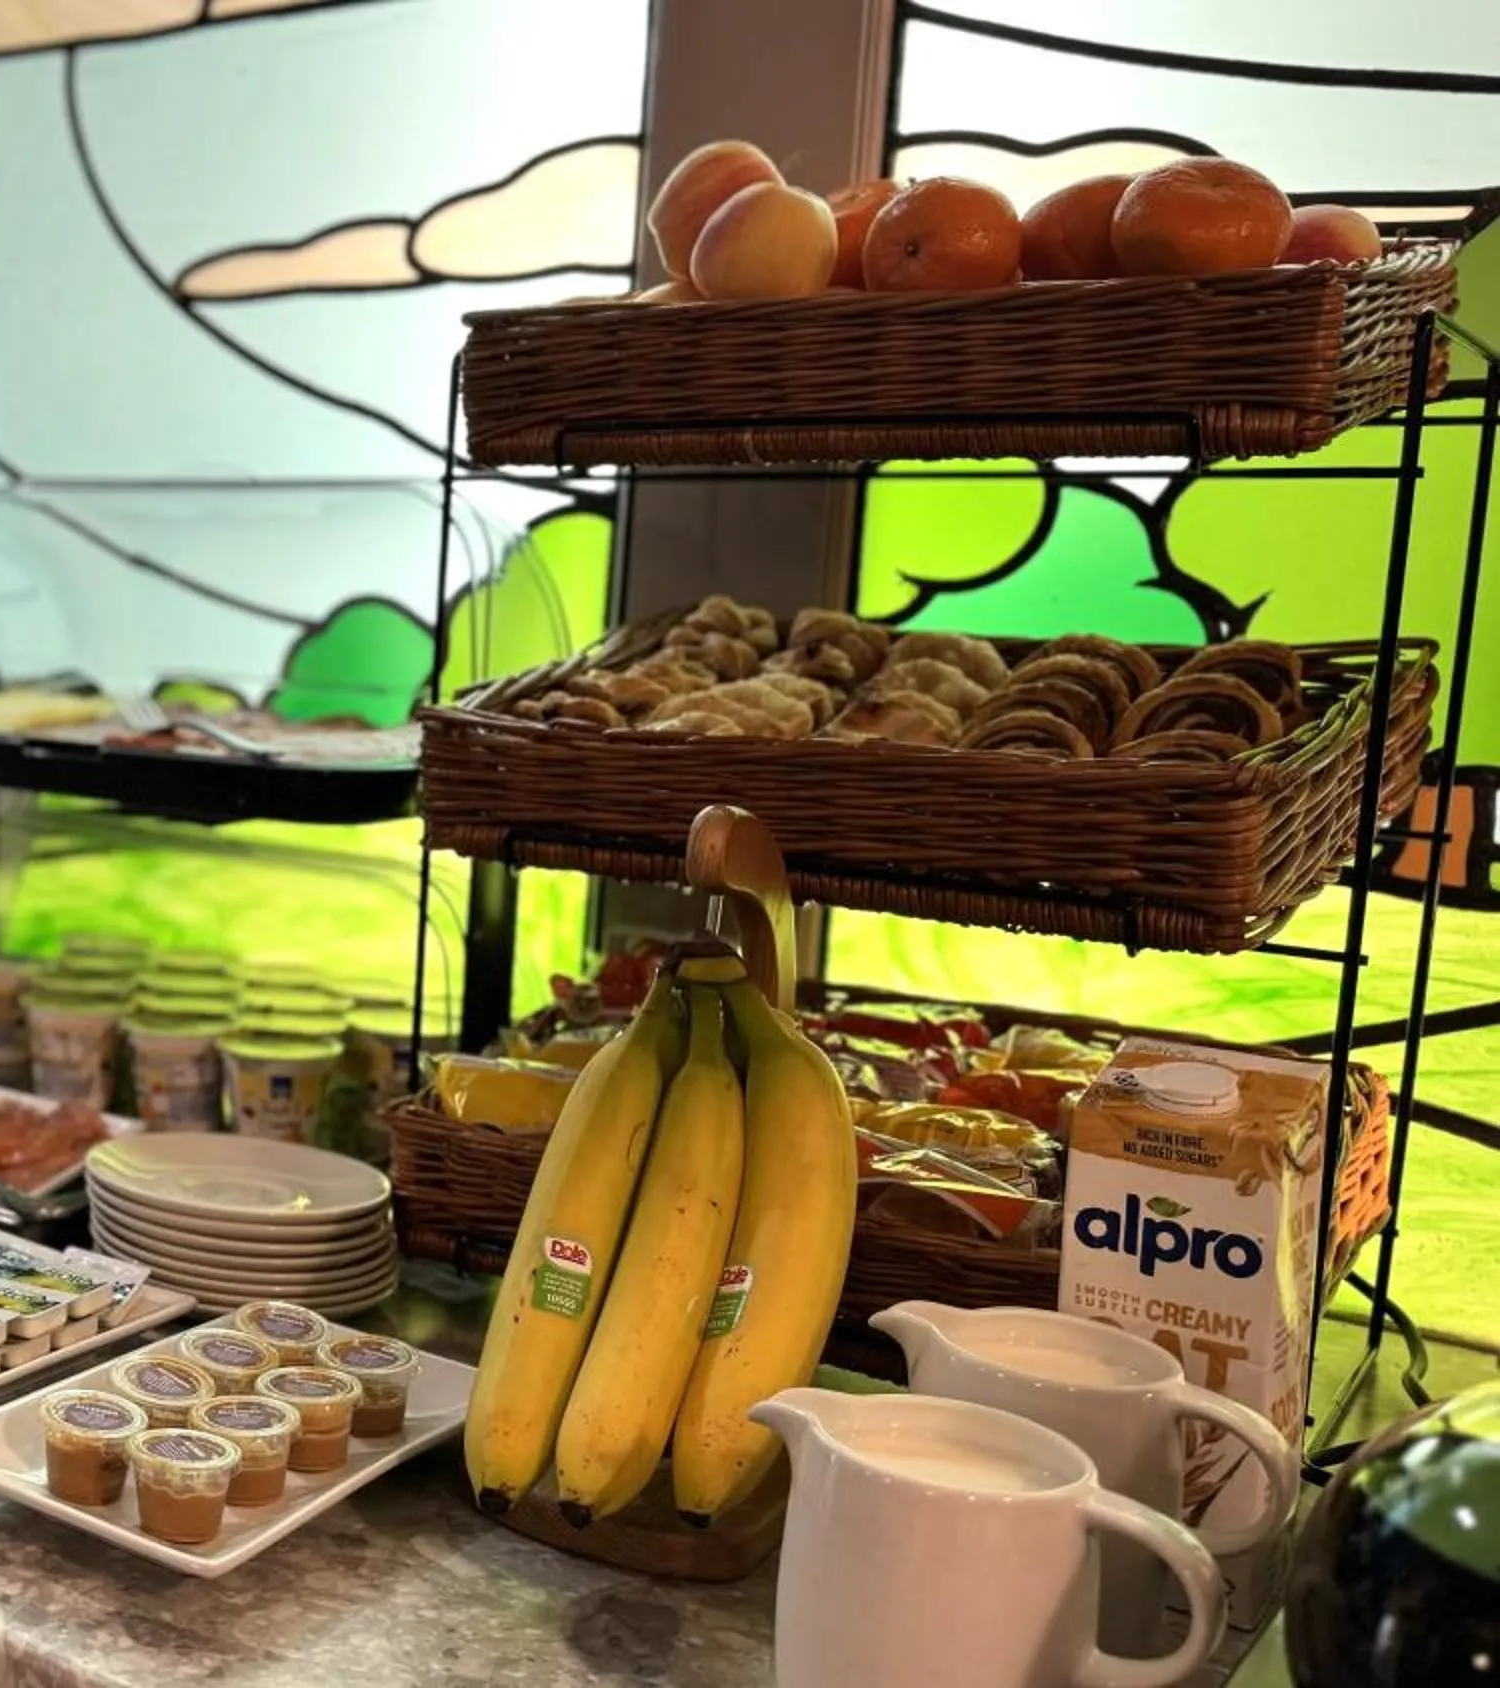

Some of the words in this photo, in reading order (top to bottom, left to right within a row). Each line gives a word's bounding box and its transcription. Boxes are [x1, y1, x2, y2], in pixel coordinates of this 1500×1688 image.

[1123, 1141, 1137, 1154] NO
[1140, 1144, 1173, 1161] ADDED
[1073, 1193, 1263, 1279] alpro
[550, 1240, 587, 1265] Dole
[1075, 1283, 1141, 1304] SMOOTH
[1075, 1295, 1140, 1317] SUBTLE
[1145, 1300, 1252, 1341] CREAMY
